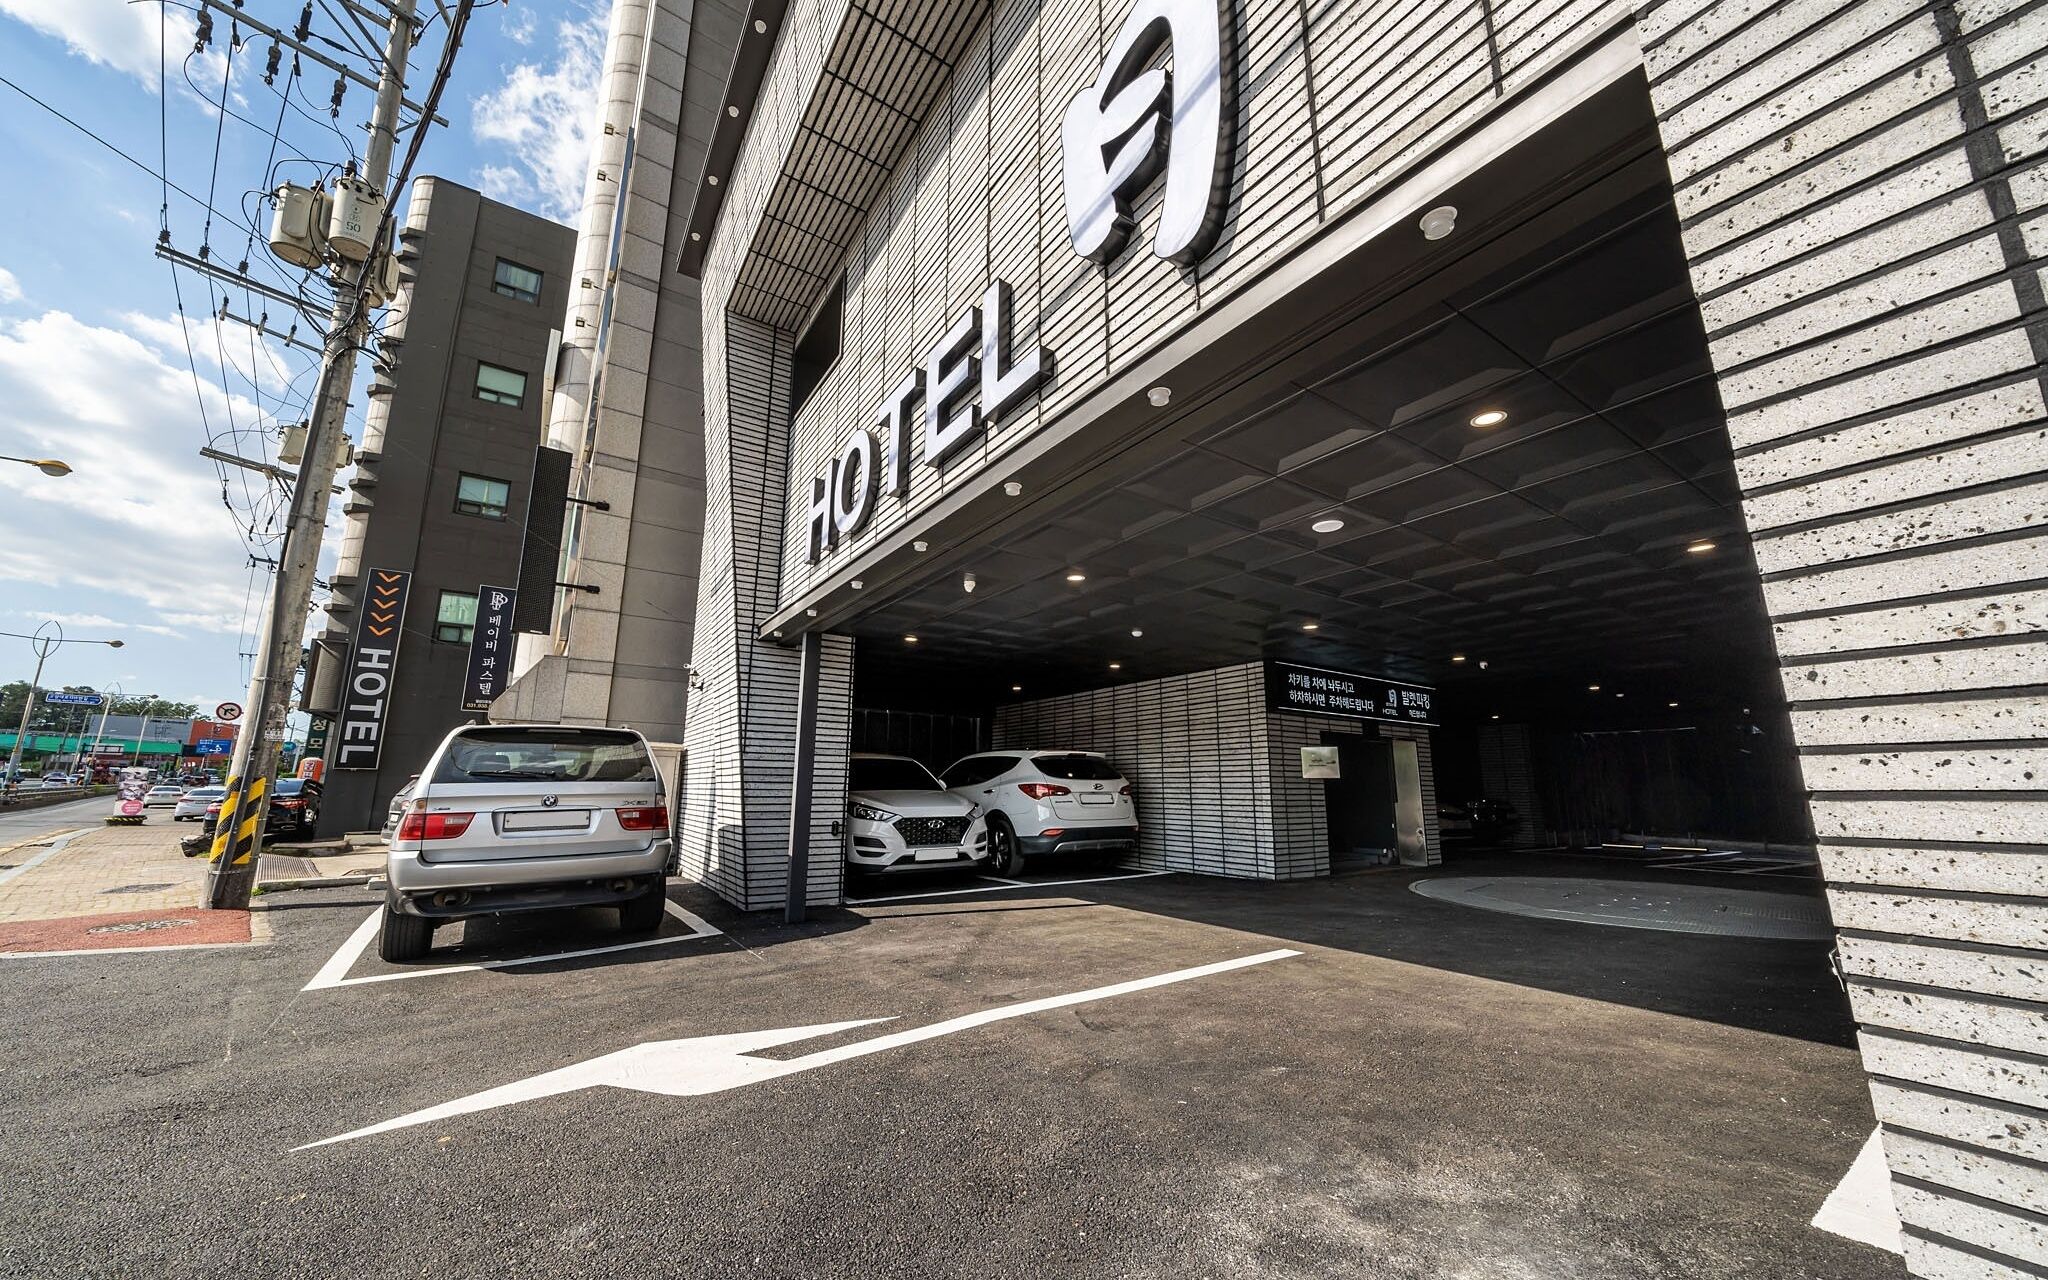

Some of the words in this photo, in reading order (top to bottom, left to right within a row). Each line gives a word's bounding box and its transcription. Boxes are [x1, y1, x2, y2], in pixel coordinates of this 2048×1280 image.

[346, 221, 361, 233] 50
[805, 277, 1054, 566] HOTEL
[1288, 672, 1310, 689] 차키를
[1312, 677, 1327, 691] 차에
[340, 647, 392, 764] HOTEL
[1288, 690, 1326, 707] 하차하시면
[1329, 695, 1374, 713] 주차해드립니다
[1401, 690, 1430, 709] 발렛파킹
[1382, 708, 1399, 716] HOTEL
